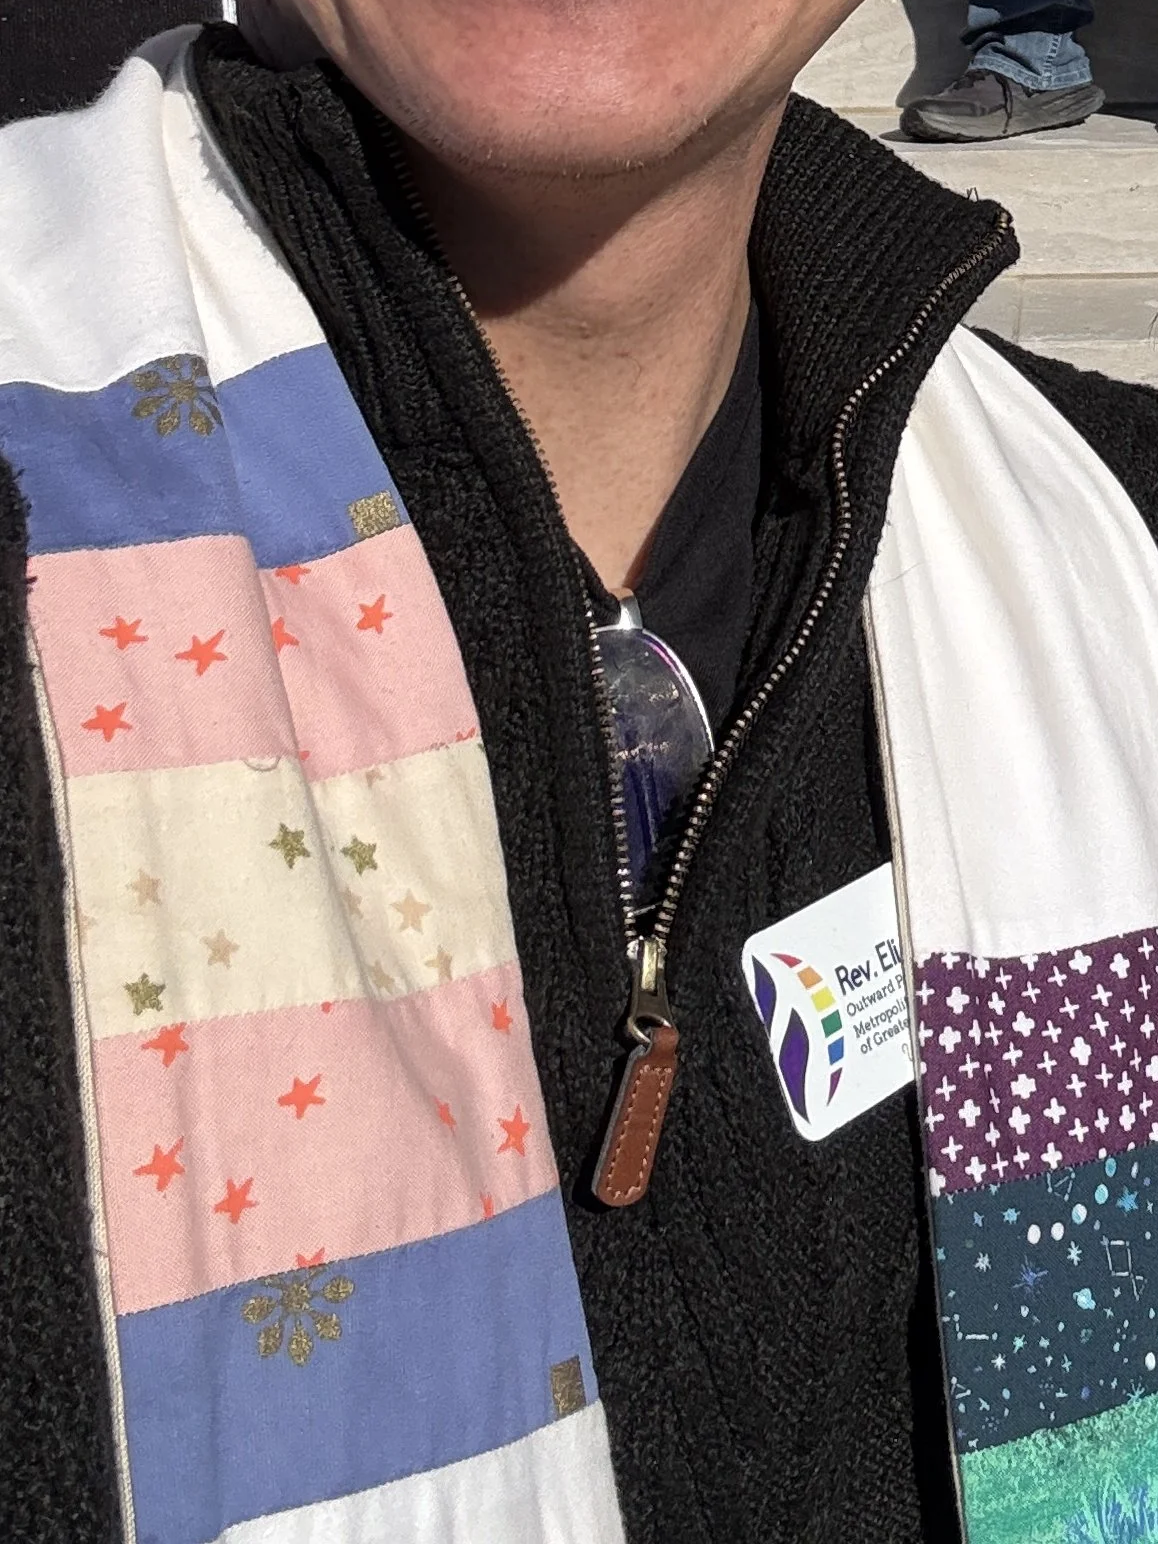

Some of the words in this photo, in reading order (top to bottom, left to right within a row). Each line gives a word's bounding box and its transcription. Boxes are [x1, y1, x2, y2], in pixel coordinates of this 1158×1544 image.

[834, 959, 879, 997] Rev.
[846, 978, 896, 1018] Outward
[852, 997, 908, 1040] Metropoli
[860, 1035, 874, 1055] of
[872, 1017, 911, 1047] Greate
